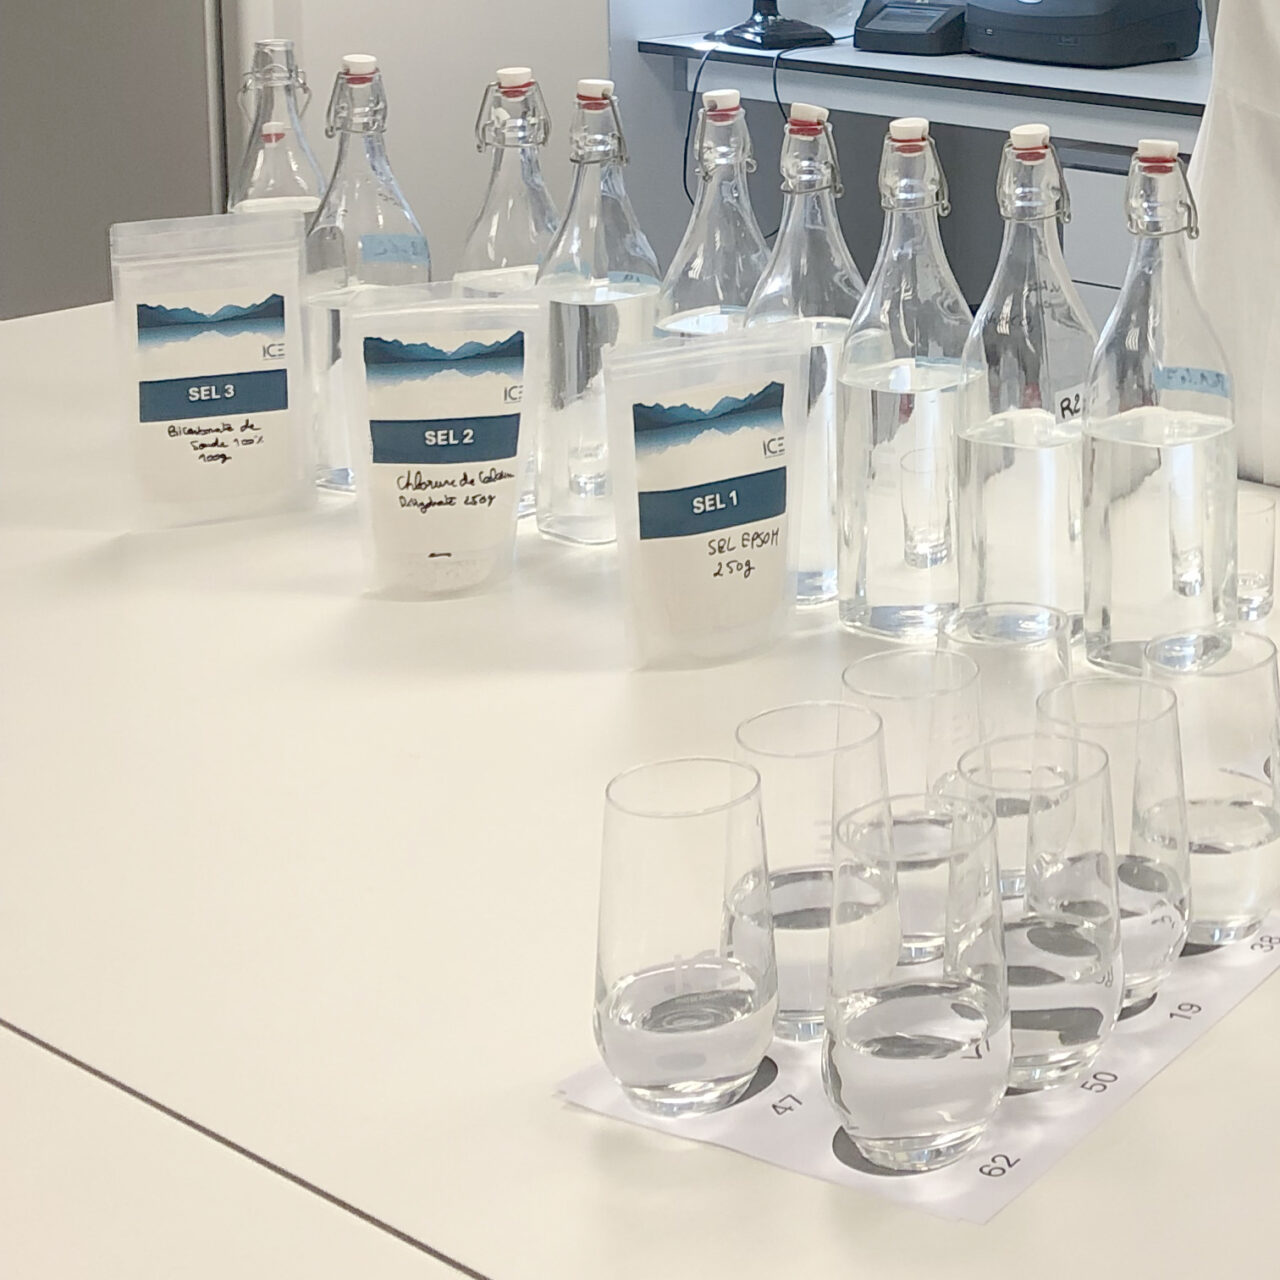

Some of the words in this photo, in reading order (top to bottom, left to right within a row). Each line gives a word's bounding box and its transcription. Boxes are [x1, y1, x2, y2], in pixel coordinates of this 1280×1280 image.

[188, 386, 221, 401] SEL
[224, 384, 235, 398] 3
[1060, 393, 1081, 419] R2
[240, 419, 261, 432] de
[425, 430, 459, 445] SEL
[462, 429, 474, 443] 2
[763, 436, 785, 455] ICE
[460, 472, 475, 487] de
[693, 493, 726, 514] SEL
[729, 490, 738, 506] 1
[708, 536, 736, 556] SEL
[713, 560, 755, 578] 250g
[1169, 1002, 1202, 1021] 19
[1080, 1071, 1118, 1093] 50
[772, 1094, 802, 1116] 47
[979, 1154, 1021, 1177] 62
